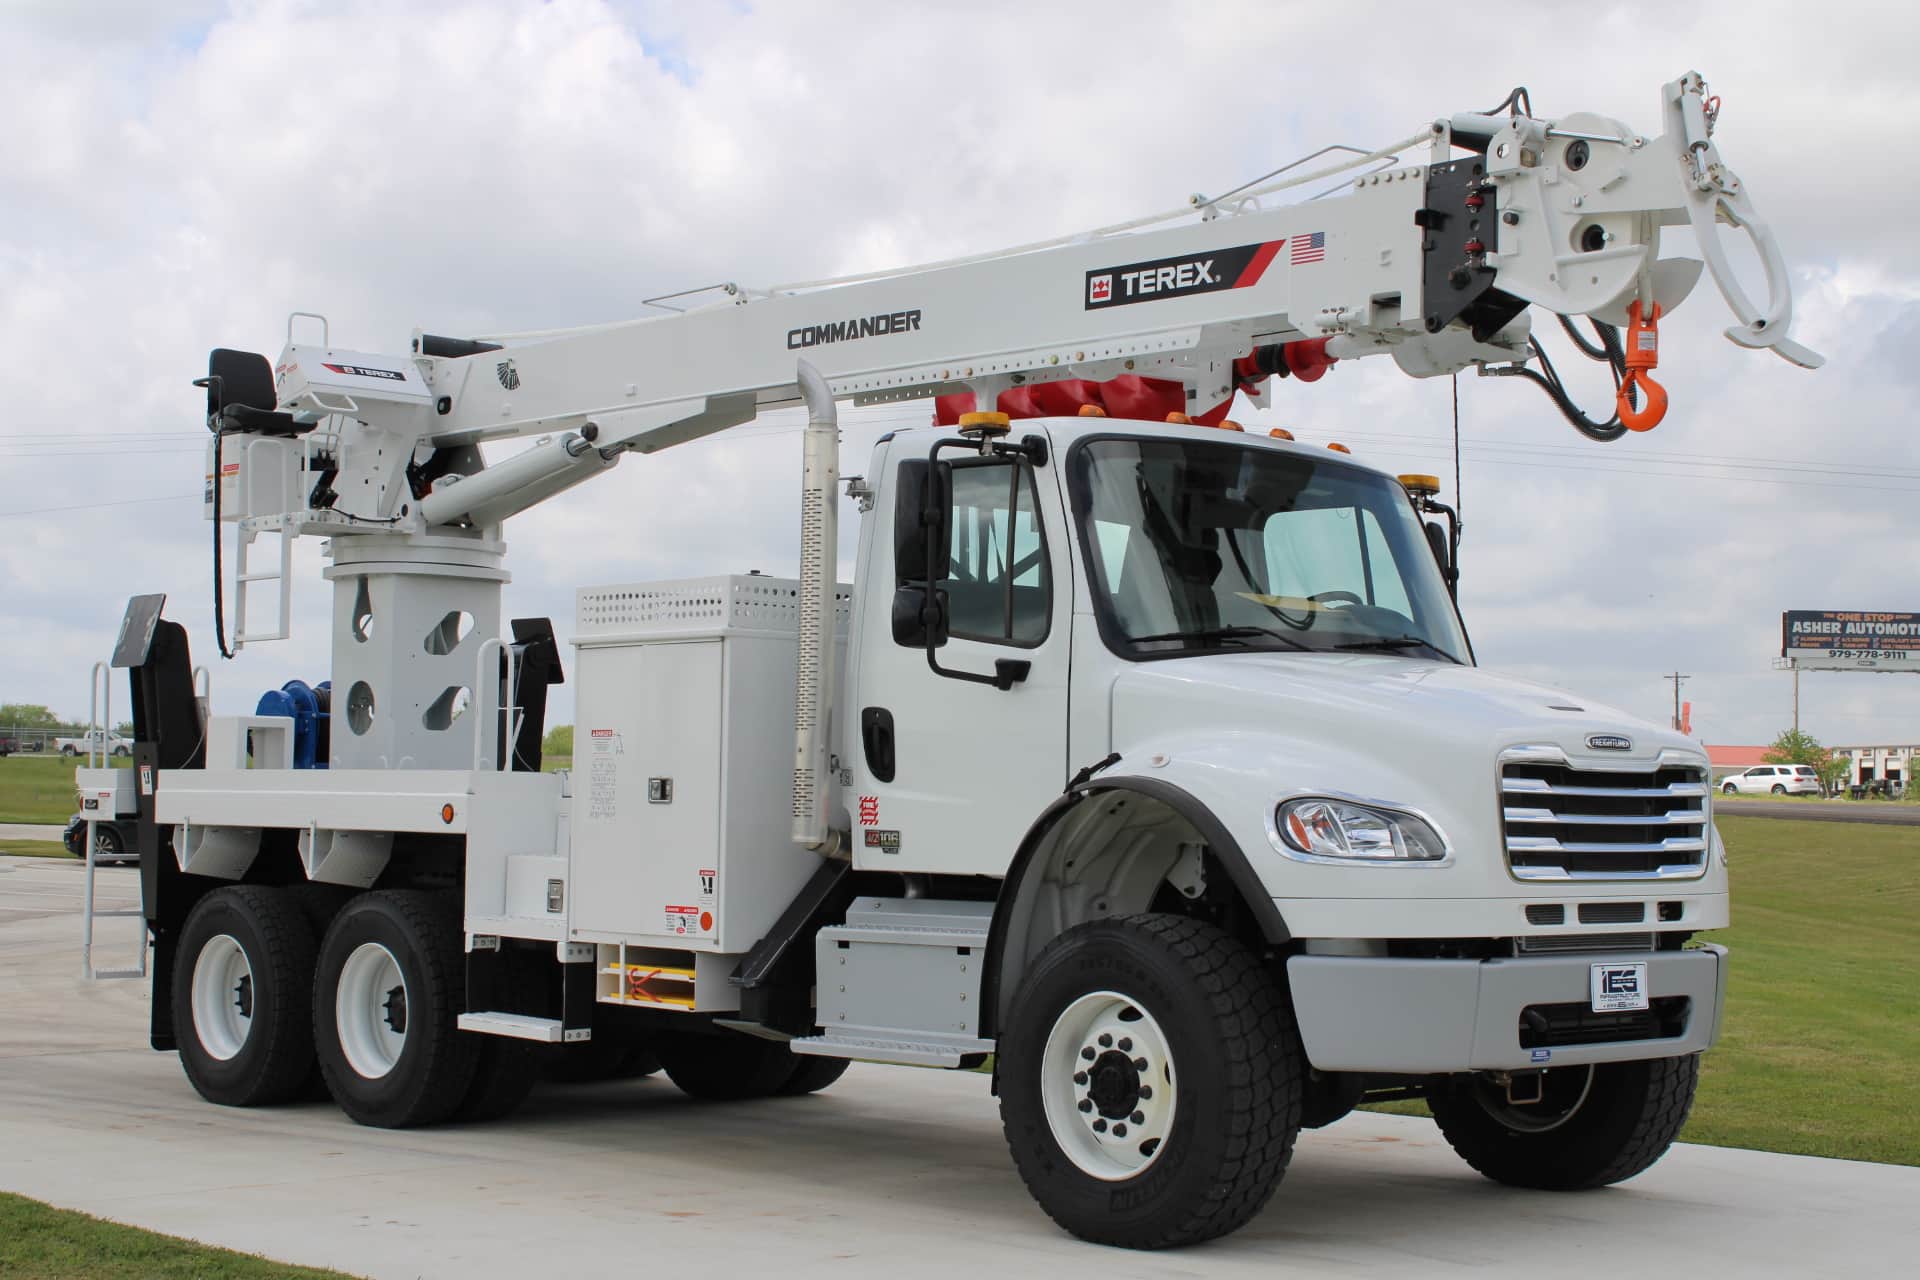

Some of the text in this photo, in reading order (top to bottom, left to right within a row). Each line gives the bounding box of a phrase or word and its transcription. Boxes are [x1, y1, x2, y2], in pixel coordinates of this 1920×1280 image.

[787, 309, 922, 350] COMMANDER
[356, 368, 396, 379] TEREX
[1836, 613, 1861, 622] ONE
[1864, 613, 1895, 622] STOP
[1792, 621, 1842, 634] ASHER
[1828, 650, 1907, 660] 979-778-9111
[880, 831, 899, 847] 106
